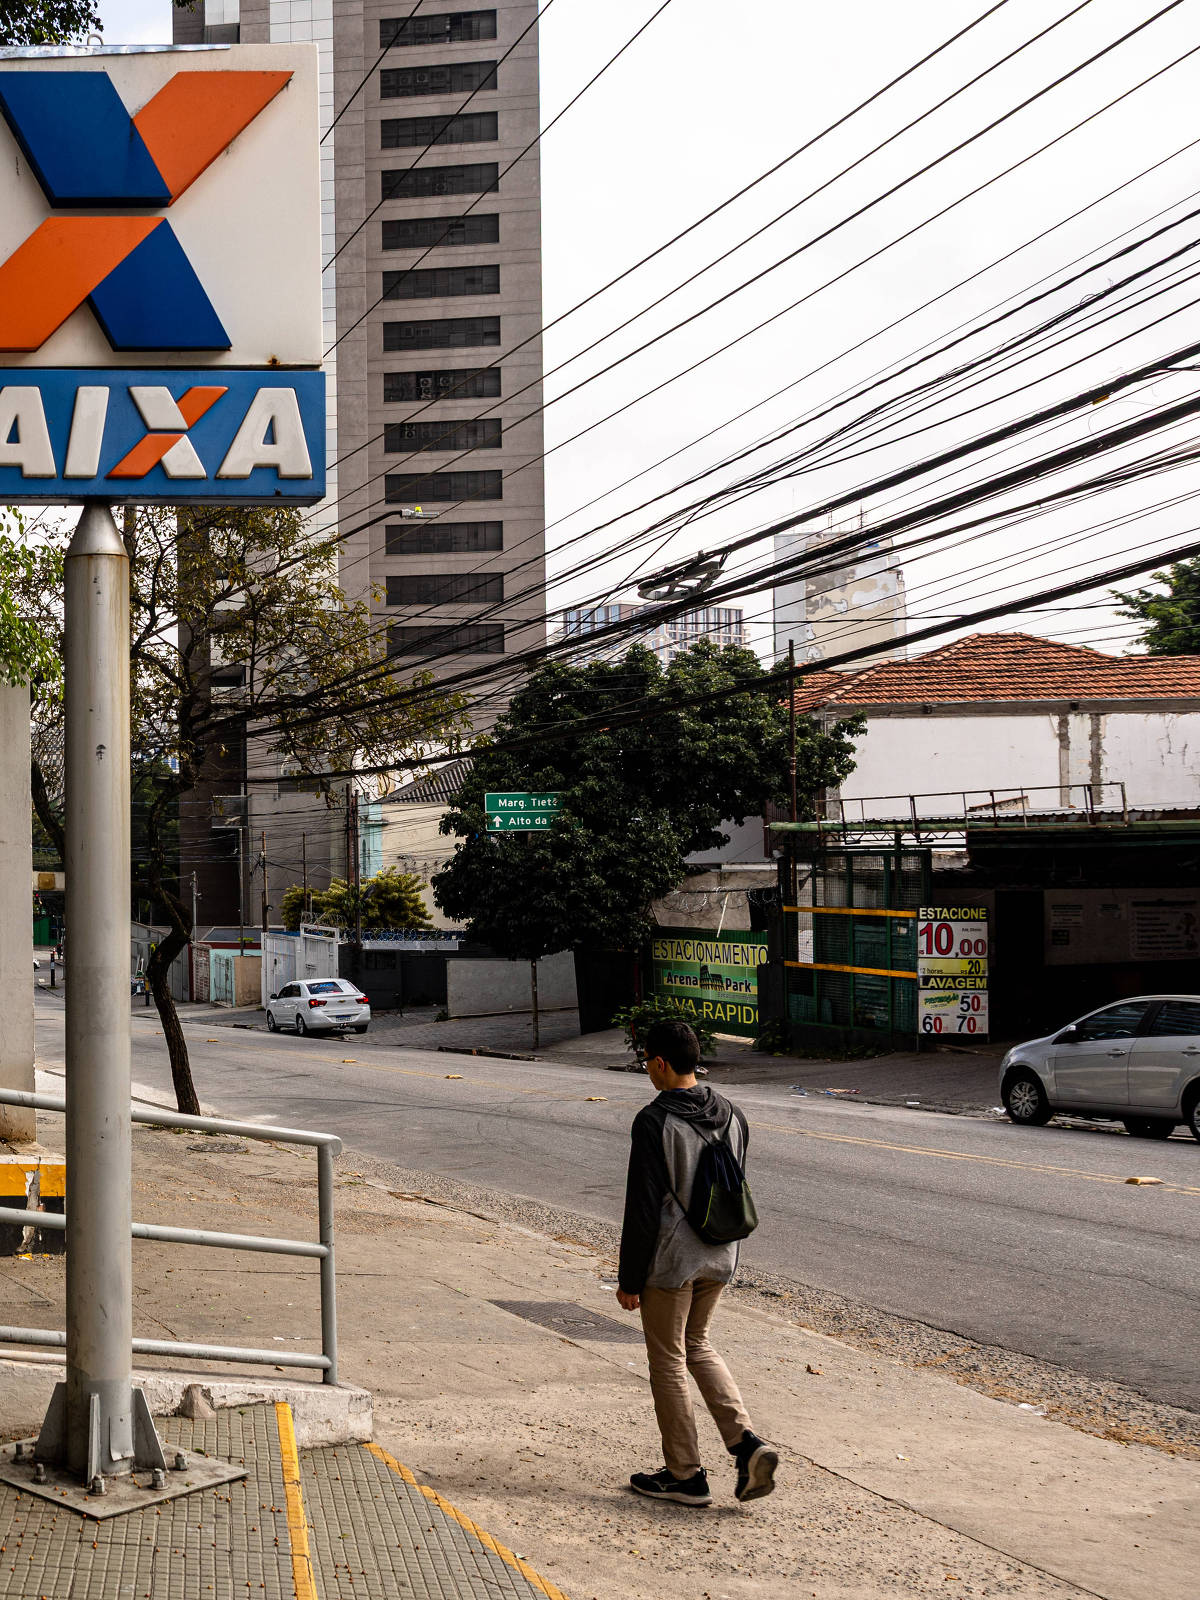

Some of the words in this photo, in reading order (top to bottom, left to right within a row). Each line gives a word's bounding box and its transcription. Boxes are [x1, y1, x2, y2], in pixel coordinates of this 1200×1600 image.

[498, 798, 527, 809] Marg.
[508, 817, 531, 826] Alto
[535, 816, 547, 825] da
[919, 907, 987, 920] ESTACIONE
[653, 940, 768, 966] ESTACIONAMENTO
[666, 972, 699, 986] Arena
[725, 978, 752, 993] Park
[919, 977, 987, 989] LAVAGEM
